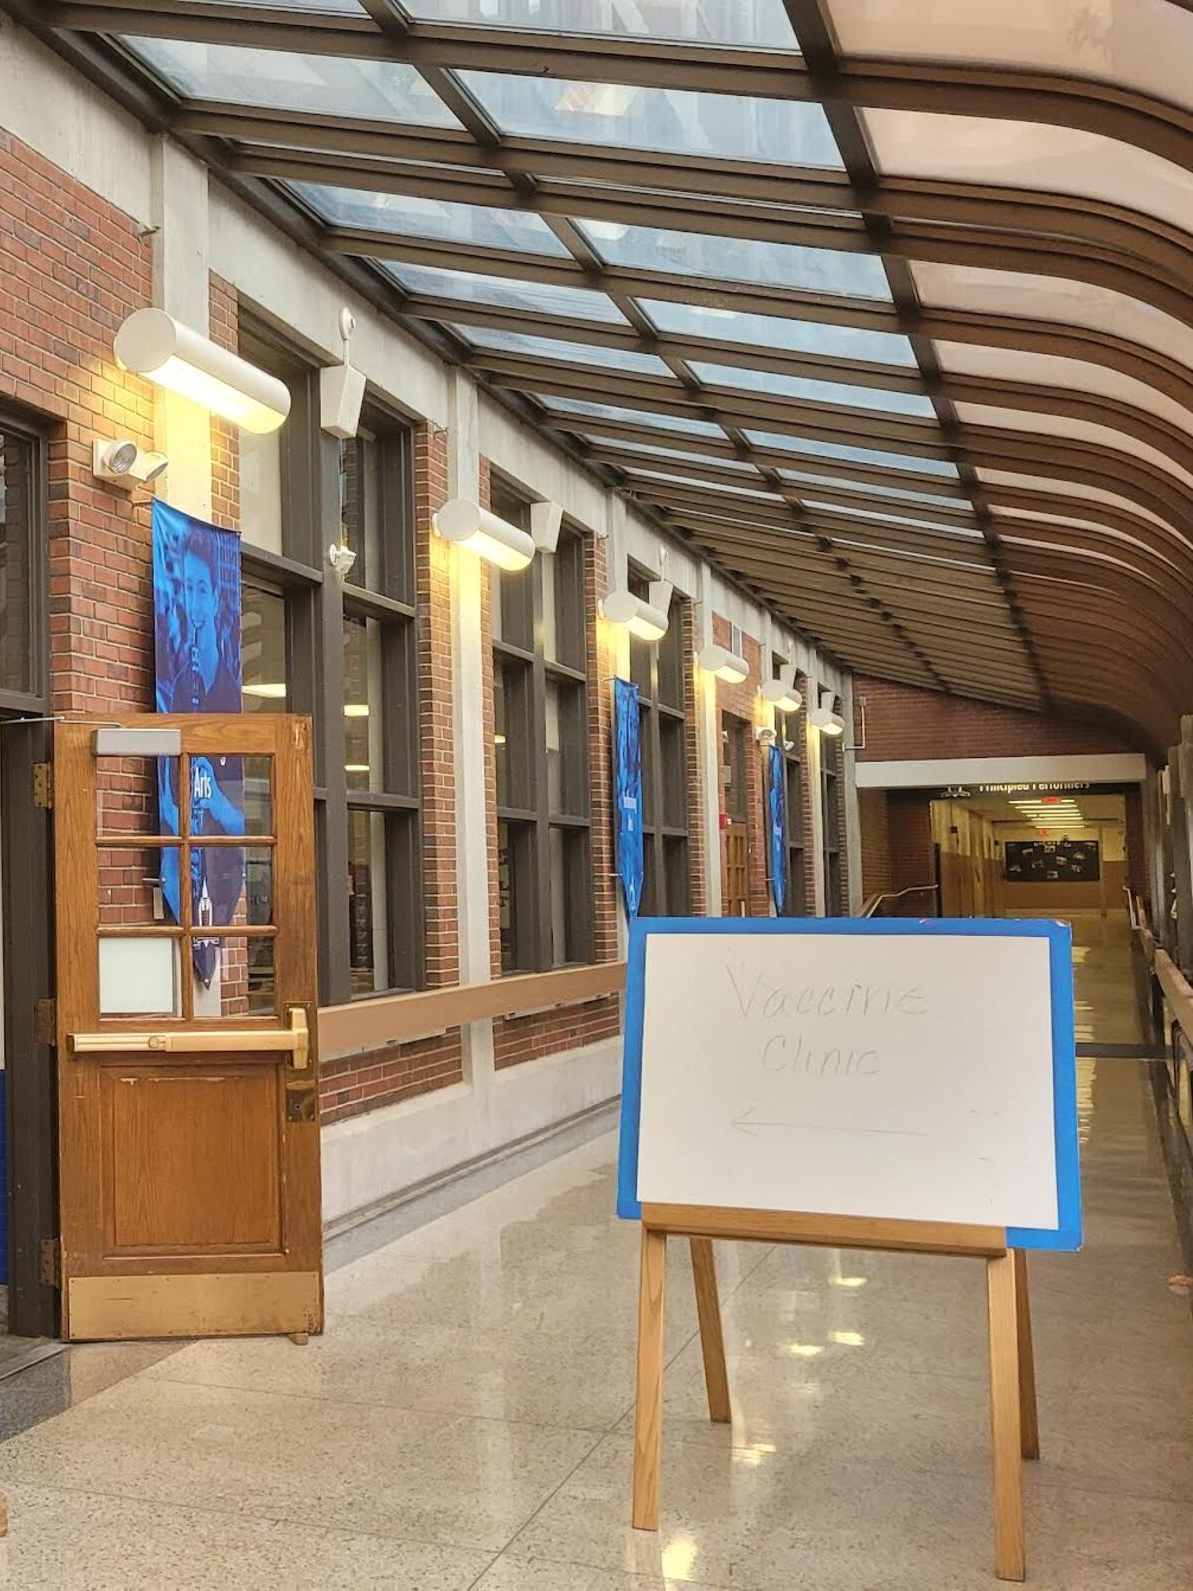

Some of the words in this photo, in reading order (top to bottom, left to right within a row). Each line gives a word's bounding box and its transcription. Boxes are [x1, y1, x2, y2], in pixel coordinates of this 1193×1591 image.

[194, 766, 212, 799] Arts
[725, 963, 927, 1019] Vaccine
[762, 1034, 881, 1077] Clinic
